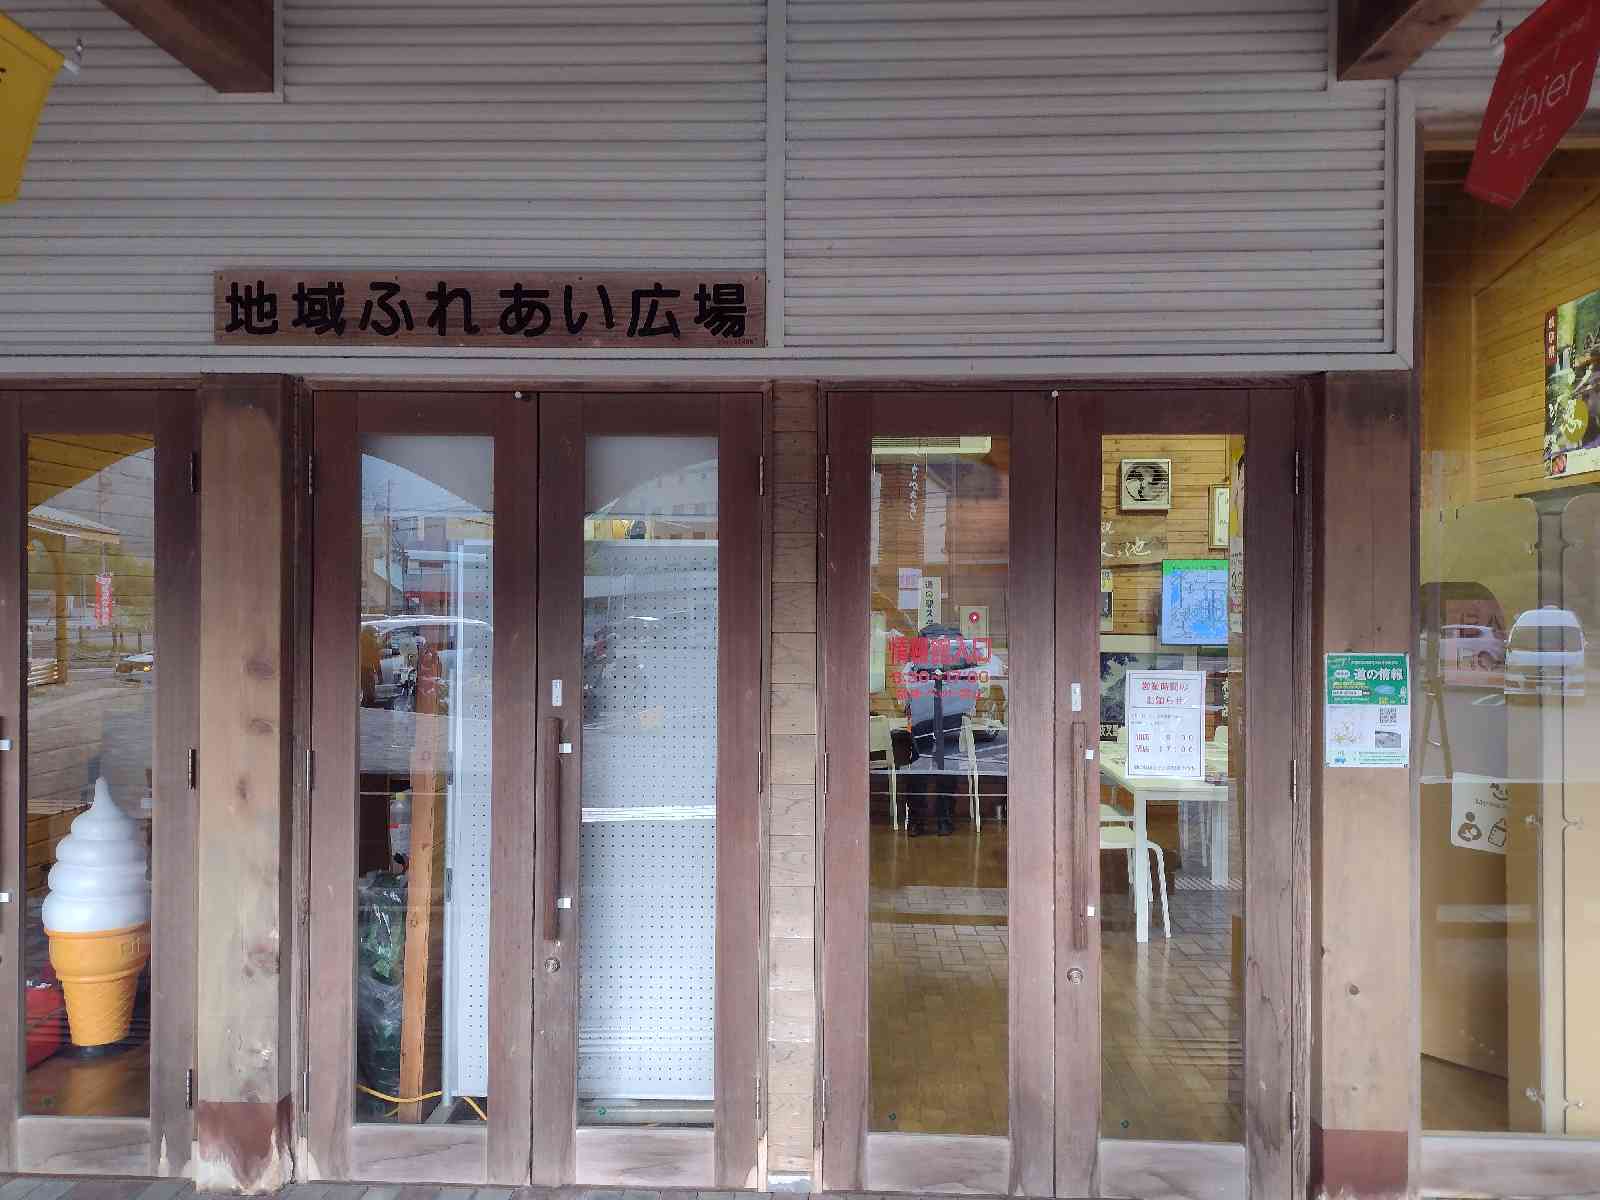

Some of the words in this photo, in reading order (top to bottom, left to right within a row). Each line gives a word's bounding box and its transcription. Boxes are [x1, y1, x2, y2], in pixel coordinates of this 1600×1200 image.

[1490, 61, 1582, 154] gibier
[224, 280, 748, 338] 地域ふれあい広場
[1353, 667, 1404, 681] 道の情報
